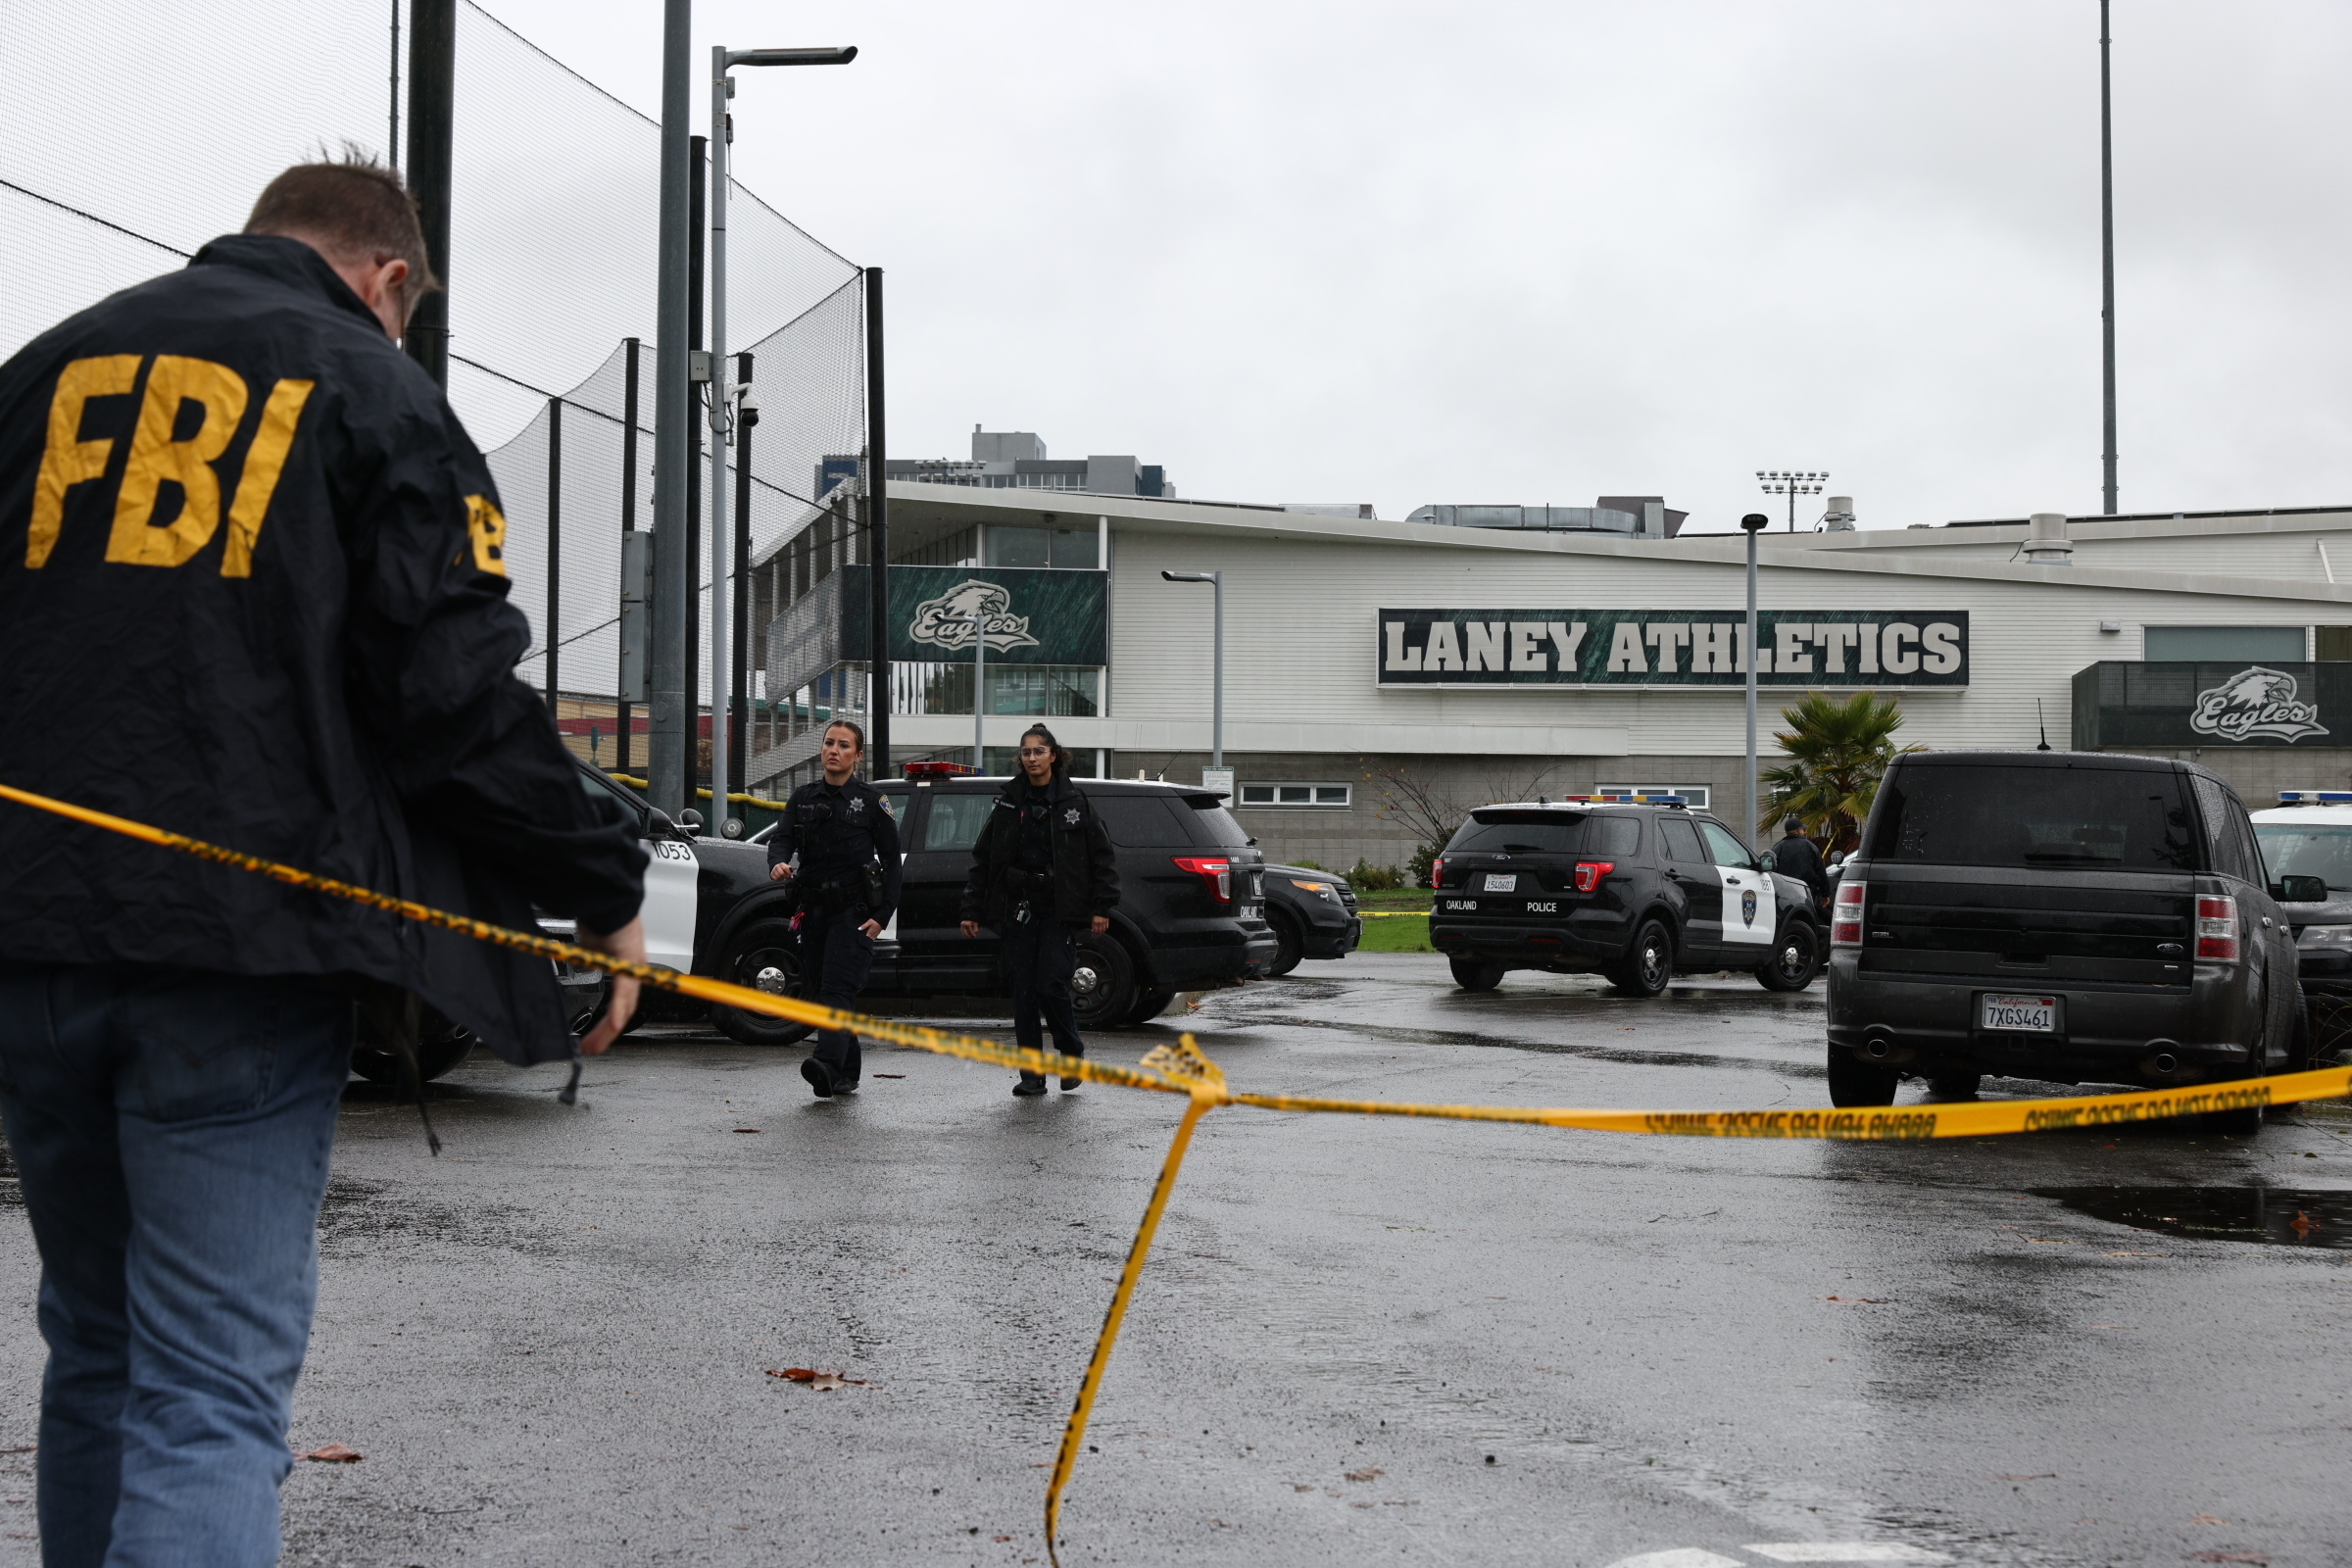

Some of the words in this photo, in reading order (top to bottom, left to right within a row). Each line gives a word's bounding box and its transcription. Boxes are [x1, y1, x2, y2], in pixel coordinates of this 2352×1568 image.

[24, 353, 315, 578] FBI
[1384, 621, 1588, 671] LANEY
[1606, 621, 1961, 675] ATHLETICS
[2195, 695, 2313, 736] Eagles
[652, 843, 691, 861] 1053
[1486, 880, 1514, 890] 1540603
[1446, 901, 1477, 910] OAKLAND
[1527, 902, 1556, 912] POLICE
[1998, 996, 2039, 1008] California
[1987, 1006, 2050, 1027] 7XGS461
